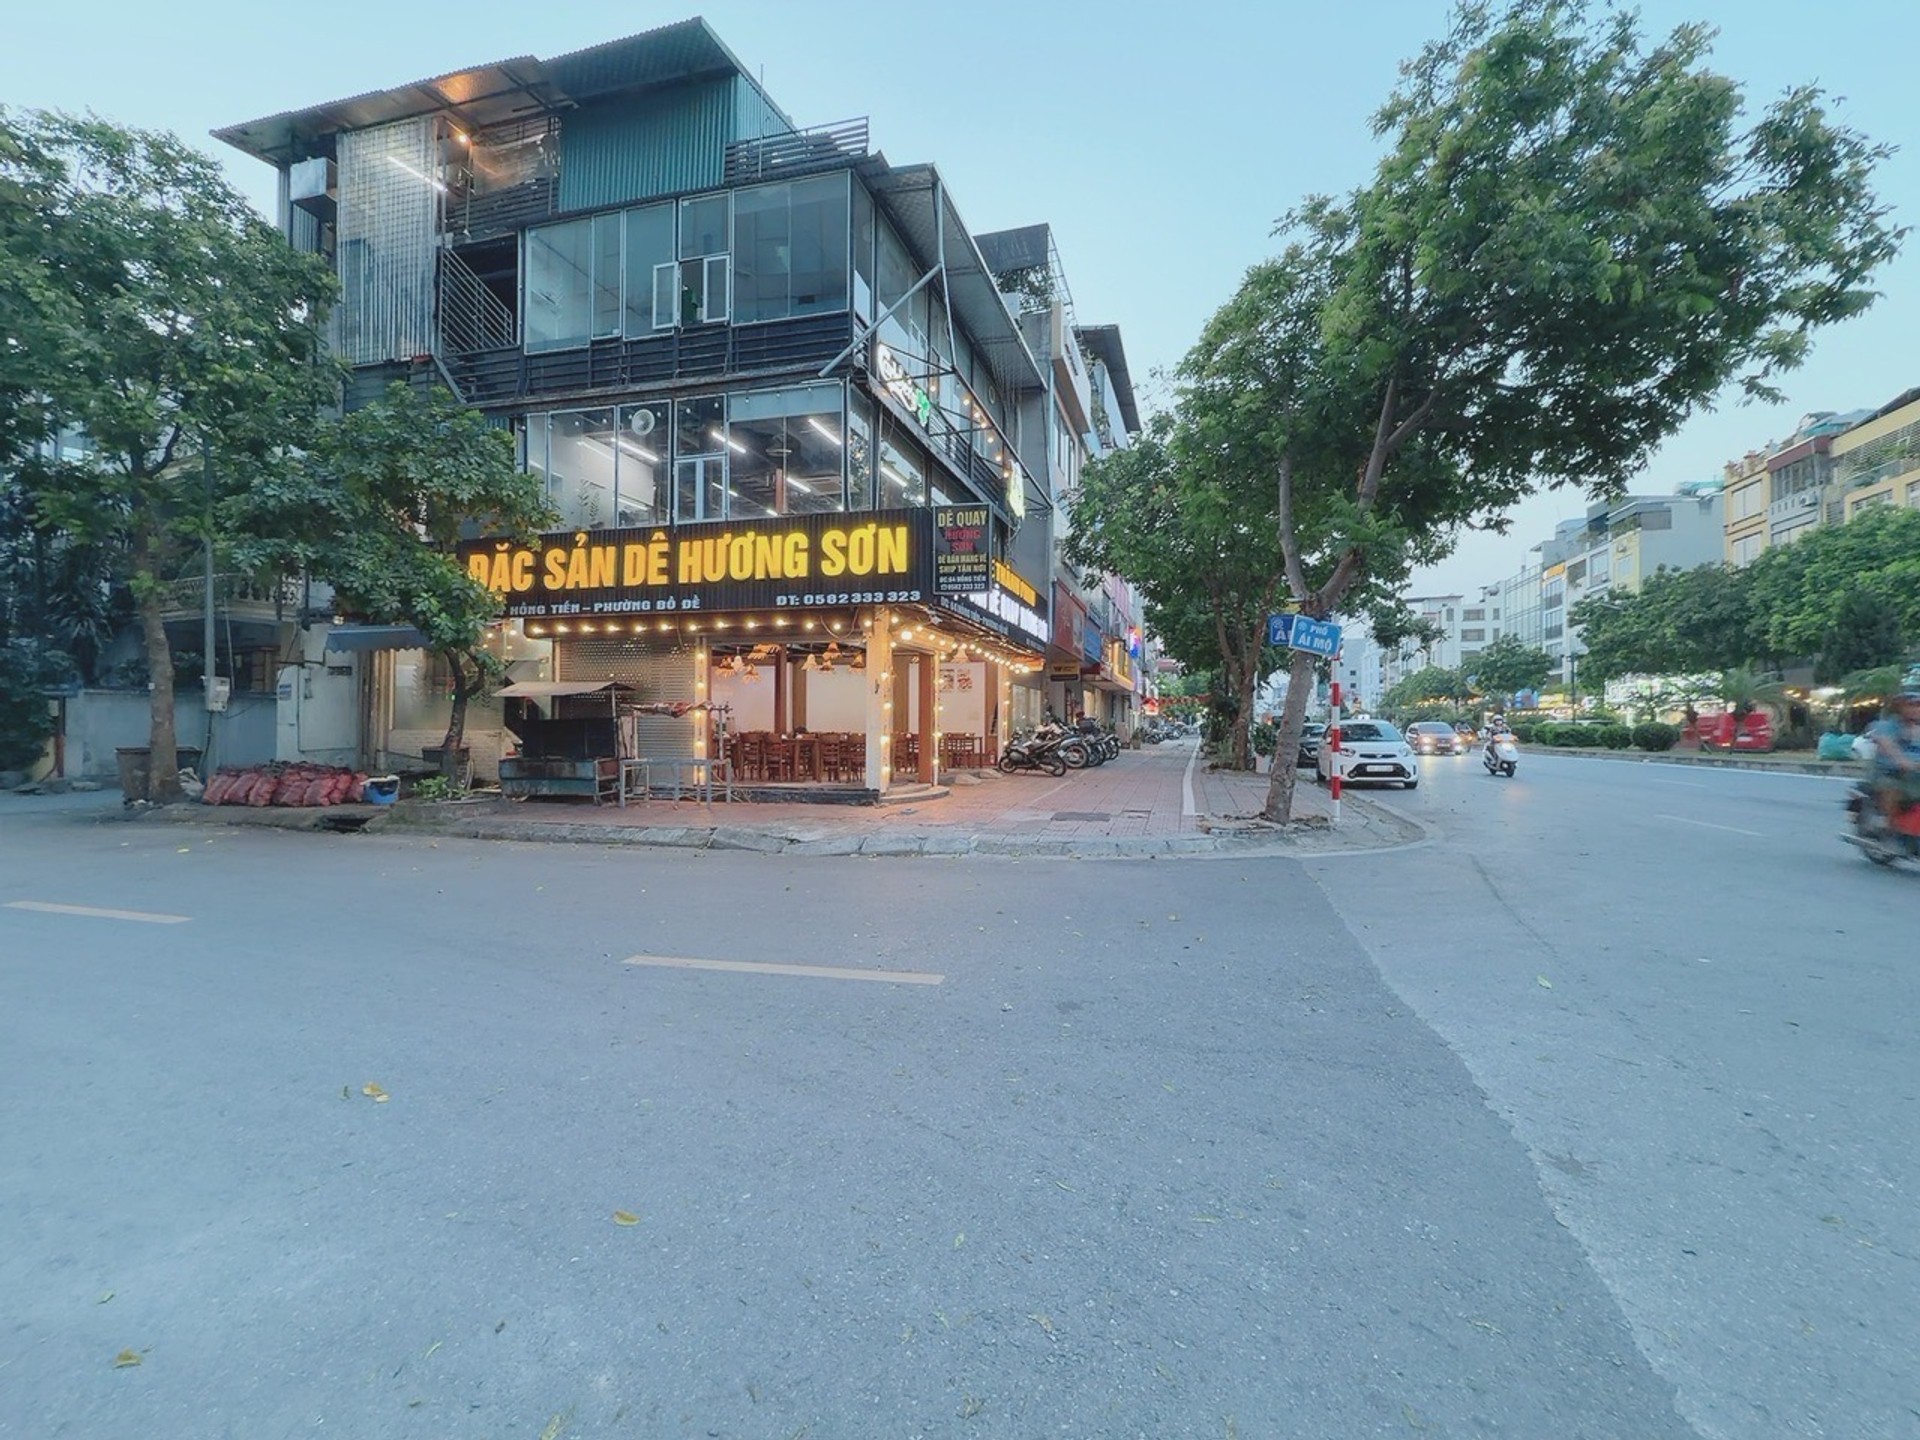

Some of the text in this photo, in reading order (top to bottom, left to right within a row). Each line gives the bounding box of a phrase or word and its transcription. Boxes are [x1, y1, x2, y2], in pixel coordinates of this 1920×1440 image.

[956, 510, 987, 527] QUAY
[543, 532, 617, 590] SẢN
[623, 531, 670, 587] DÊ
[678, 531, 809, 584] HƯƠNG
[820, 523, 908, 577] SƠN
[887, 590, 921, 602] 323
